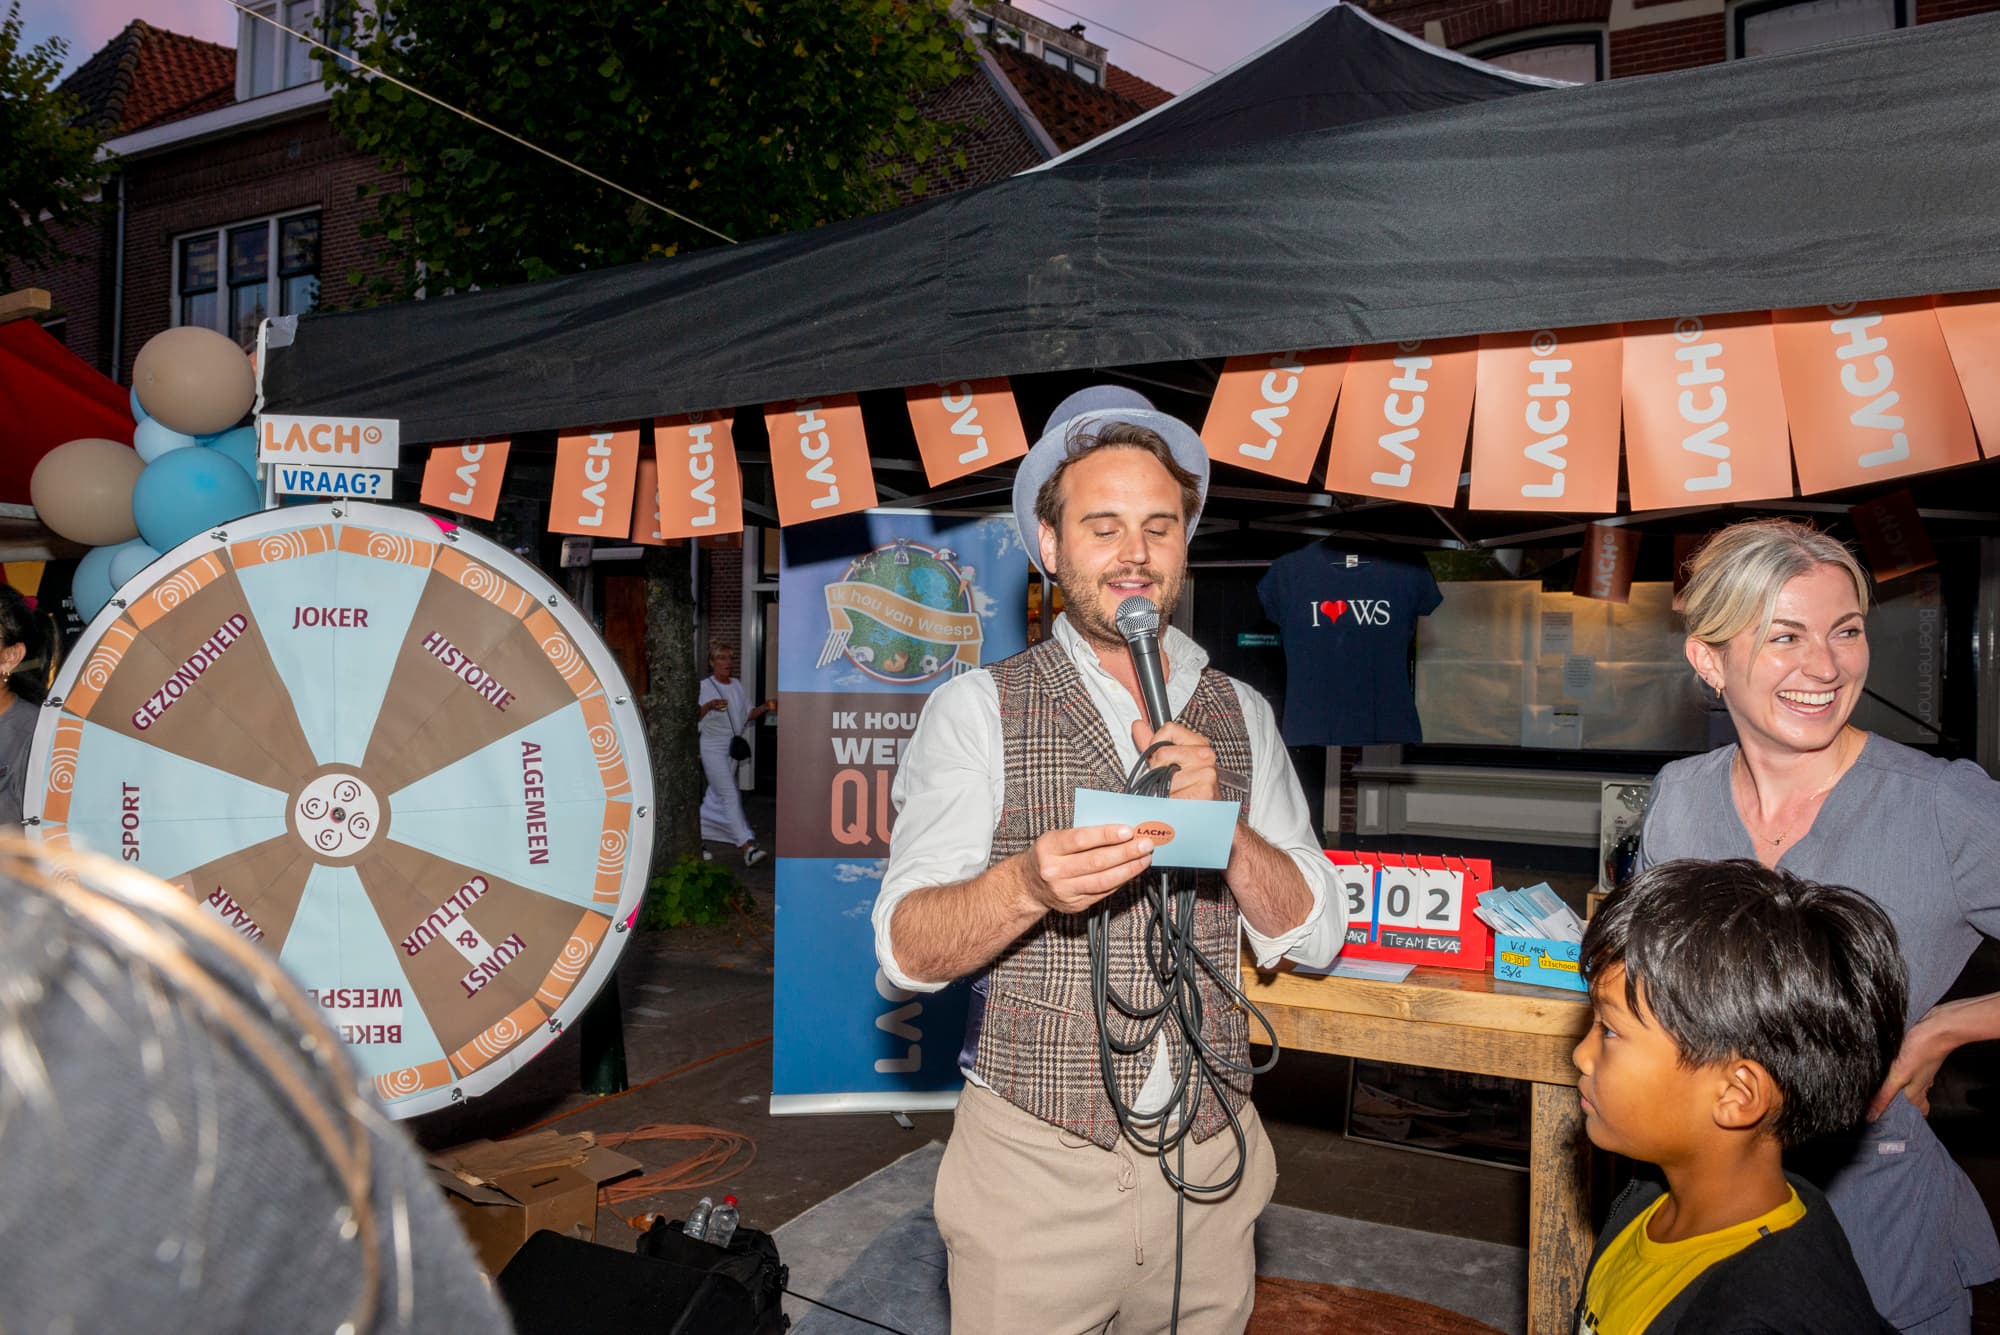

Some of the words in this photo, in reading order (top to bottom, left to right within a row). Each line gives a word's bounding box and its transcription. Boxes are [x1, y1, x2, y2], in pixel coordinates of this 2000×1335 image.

[282, 470, 381, 495] VRAAG?
[292, 606, 369, 630] JOKER
[851, 589, 882, 611] hou
[885, 606, 914, 627] van
[918, 618, 974, 640] Weesp
[1310, 601, 1320, 627] I
[1347, 599, 1391, 626] WS
[131, 613, 249, 731] GEZONDHEID
[421, 630, 517, 713] HISTORIE
[832, 711, 858, 729] IK
[864, 712, 917, 730] HOU
[121, 781, 140, 862] SPORT
[521, 741, 549, 865] ALGEMEEN
[208, 885, 265, 943] WAAR
[400, 875, 490, 957] CULTUUR
[456, 930, 479, 949] &
[460, 933, 527, 999] KUNST
[1386, 932, 1424, 949] TEAM
[1426, 937, 1461, 955] EVA
[338, 1025, 402, 1045] BEKE
